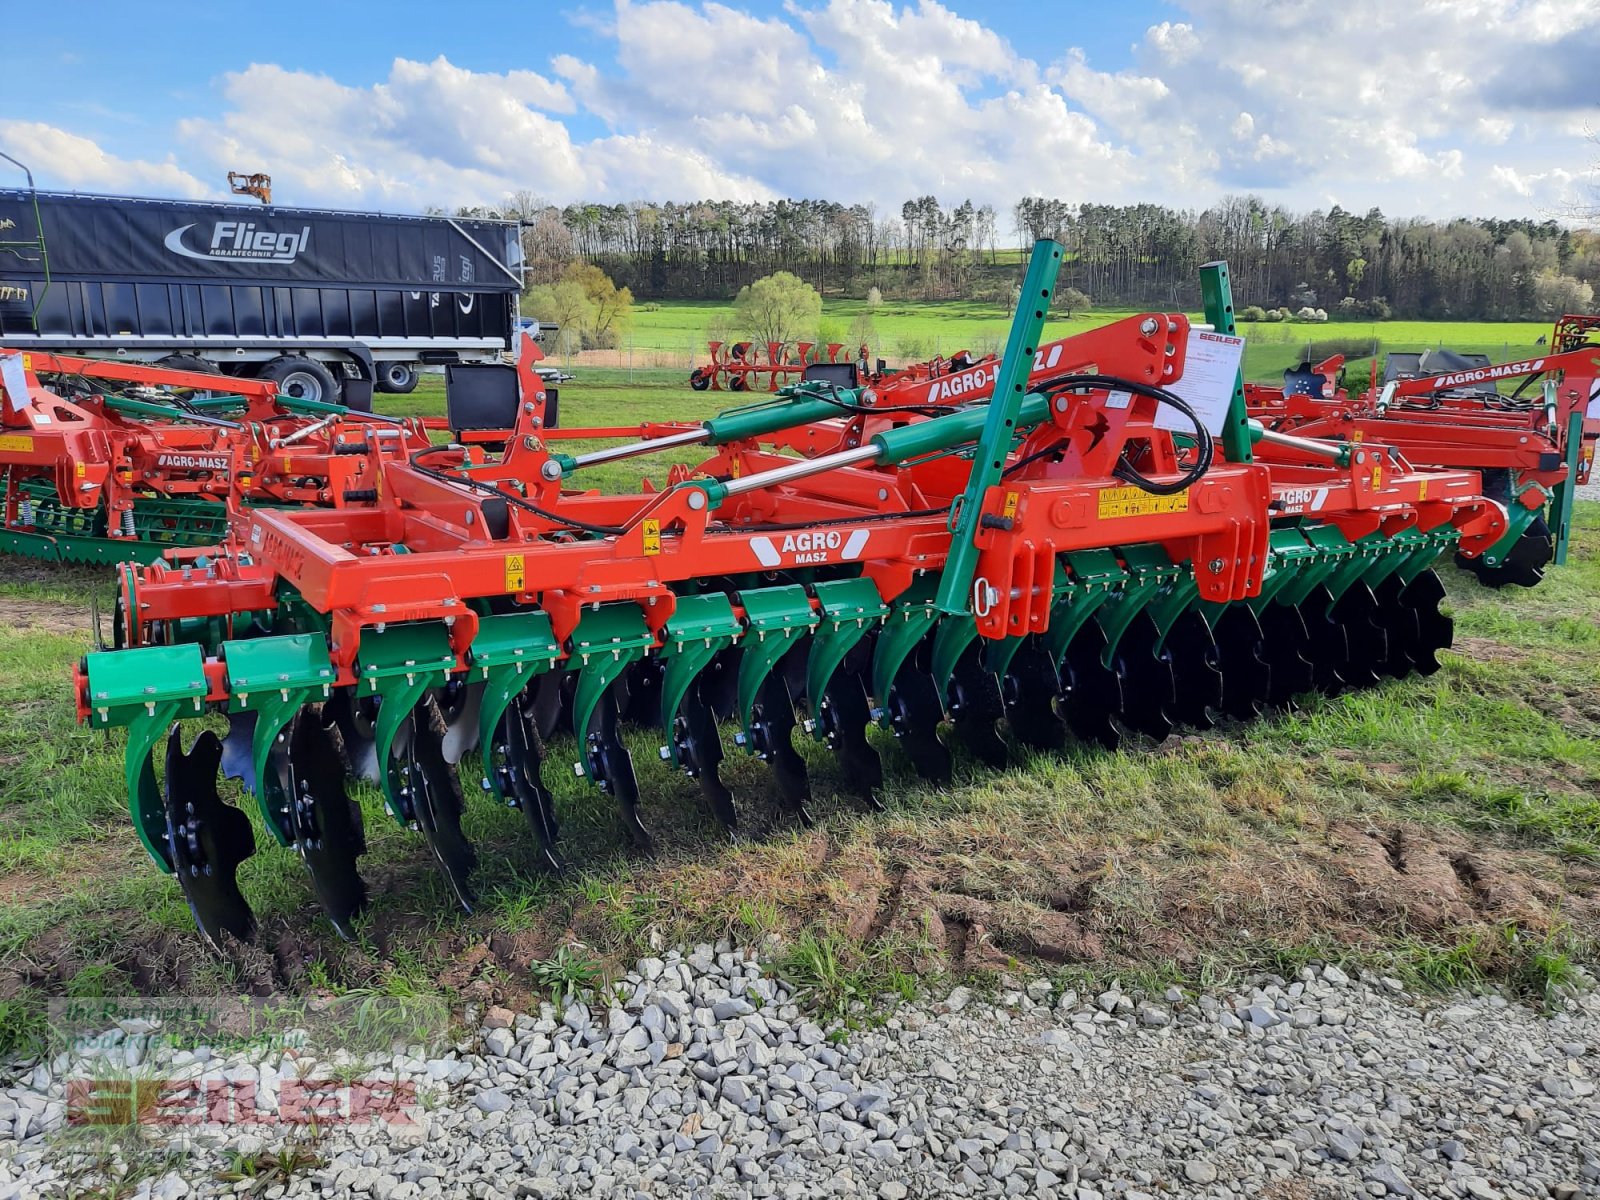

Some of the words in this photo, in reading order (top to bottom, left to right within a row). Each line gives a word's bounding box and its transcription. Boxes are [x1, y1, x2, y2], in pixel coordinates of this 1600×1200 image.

[210, 221, 311, 258] Fliegl
[209, 249, 272, 258] AGRARTECHNIK
[431, 255, 441, 308] TARUS
[1199, 332, 1243, 346] SEILER
[940, 350, 1046, 400] AGRO-Z
[1445, 362, 1533, 387] AGRO-MASZ
[166, 455, 229, 470] AGRO-MASZ
[1279, 488, 1313, 505] AGRO
[1284, 505, 1304, 514] MASZ
[781, 531, 842, 553] AGRO
[795, 551, 828, 565] MASZ
